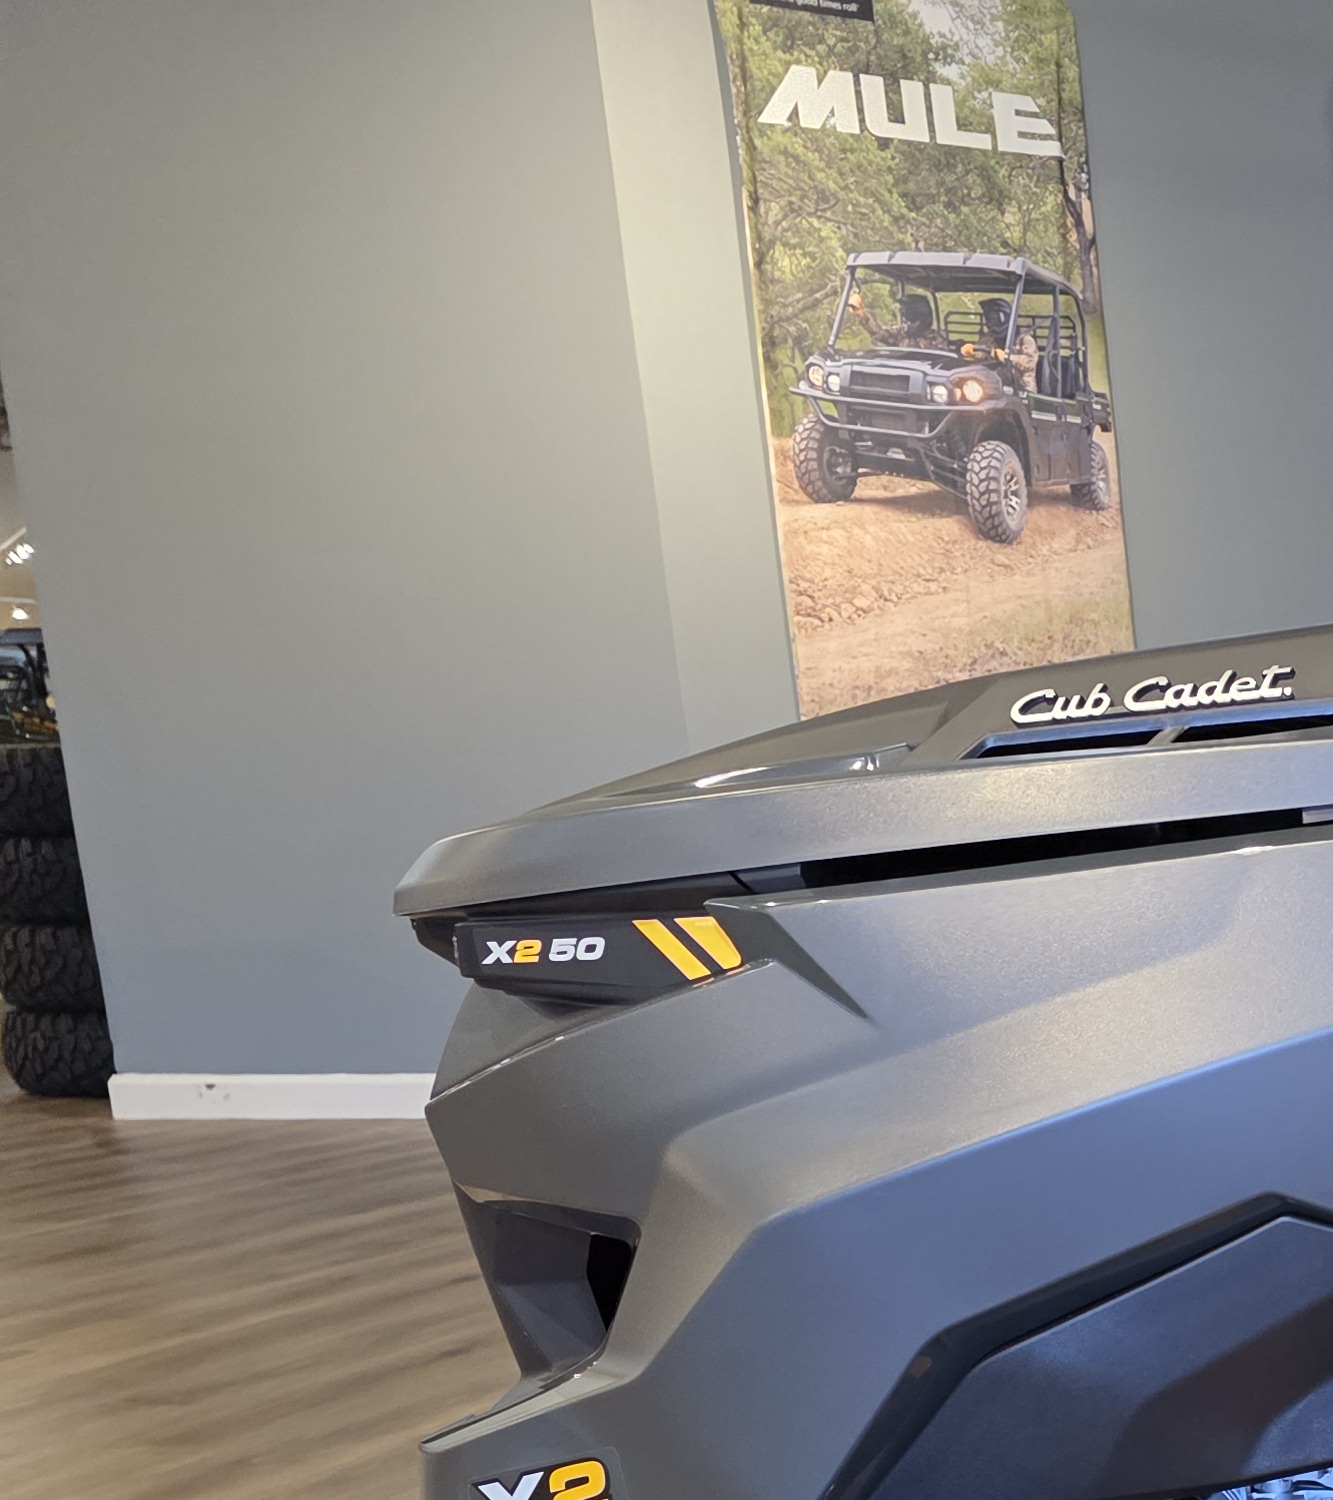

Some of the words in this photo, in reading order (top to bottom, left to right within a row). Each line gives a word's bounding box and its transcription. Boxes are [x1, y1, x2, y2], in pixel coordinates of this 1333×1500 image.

[757, 65, 1066, 158] MULE
[1009, 682, 1115, 725] Cub
[481, 939, 543, 965] X2
[548, 937, 606, 962] 50
